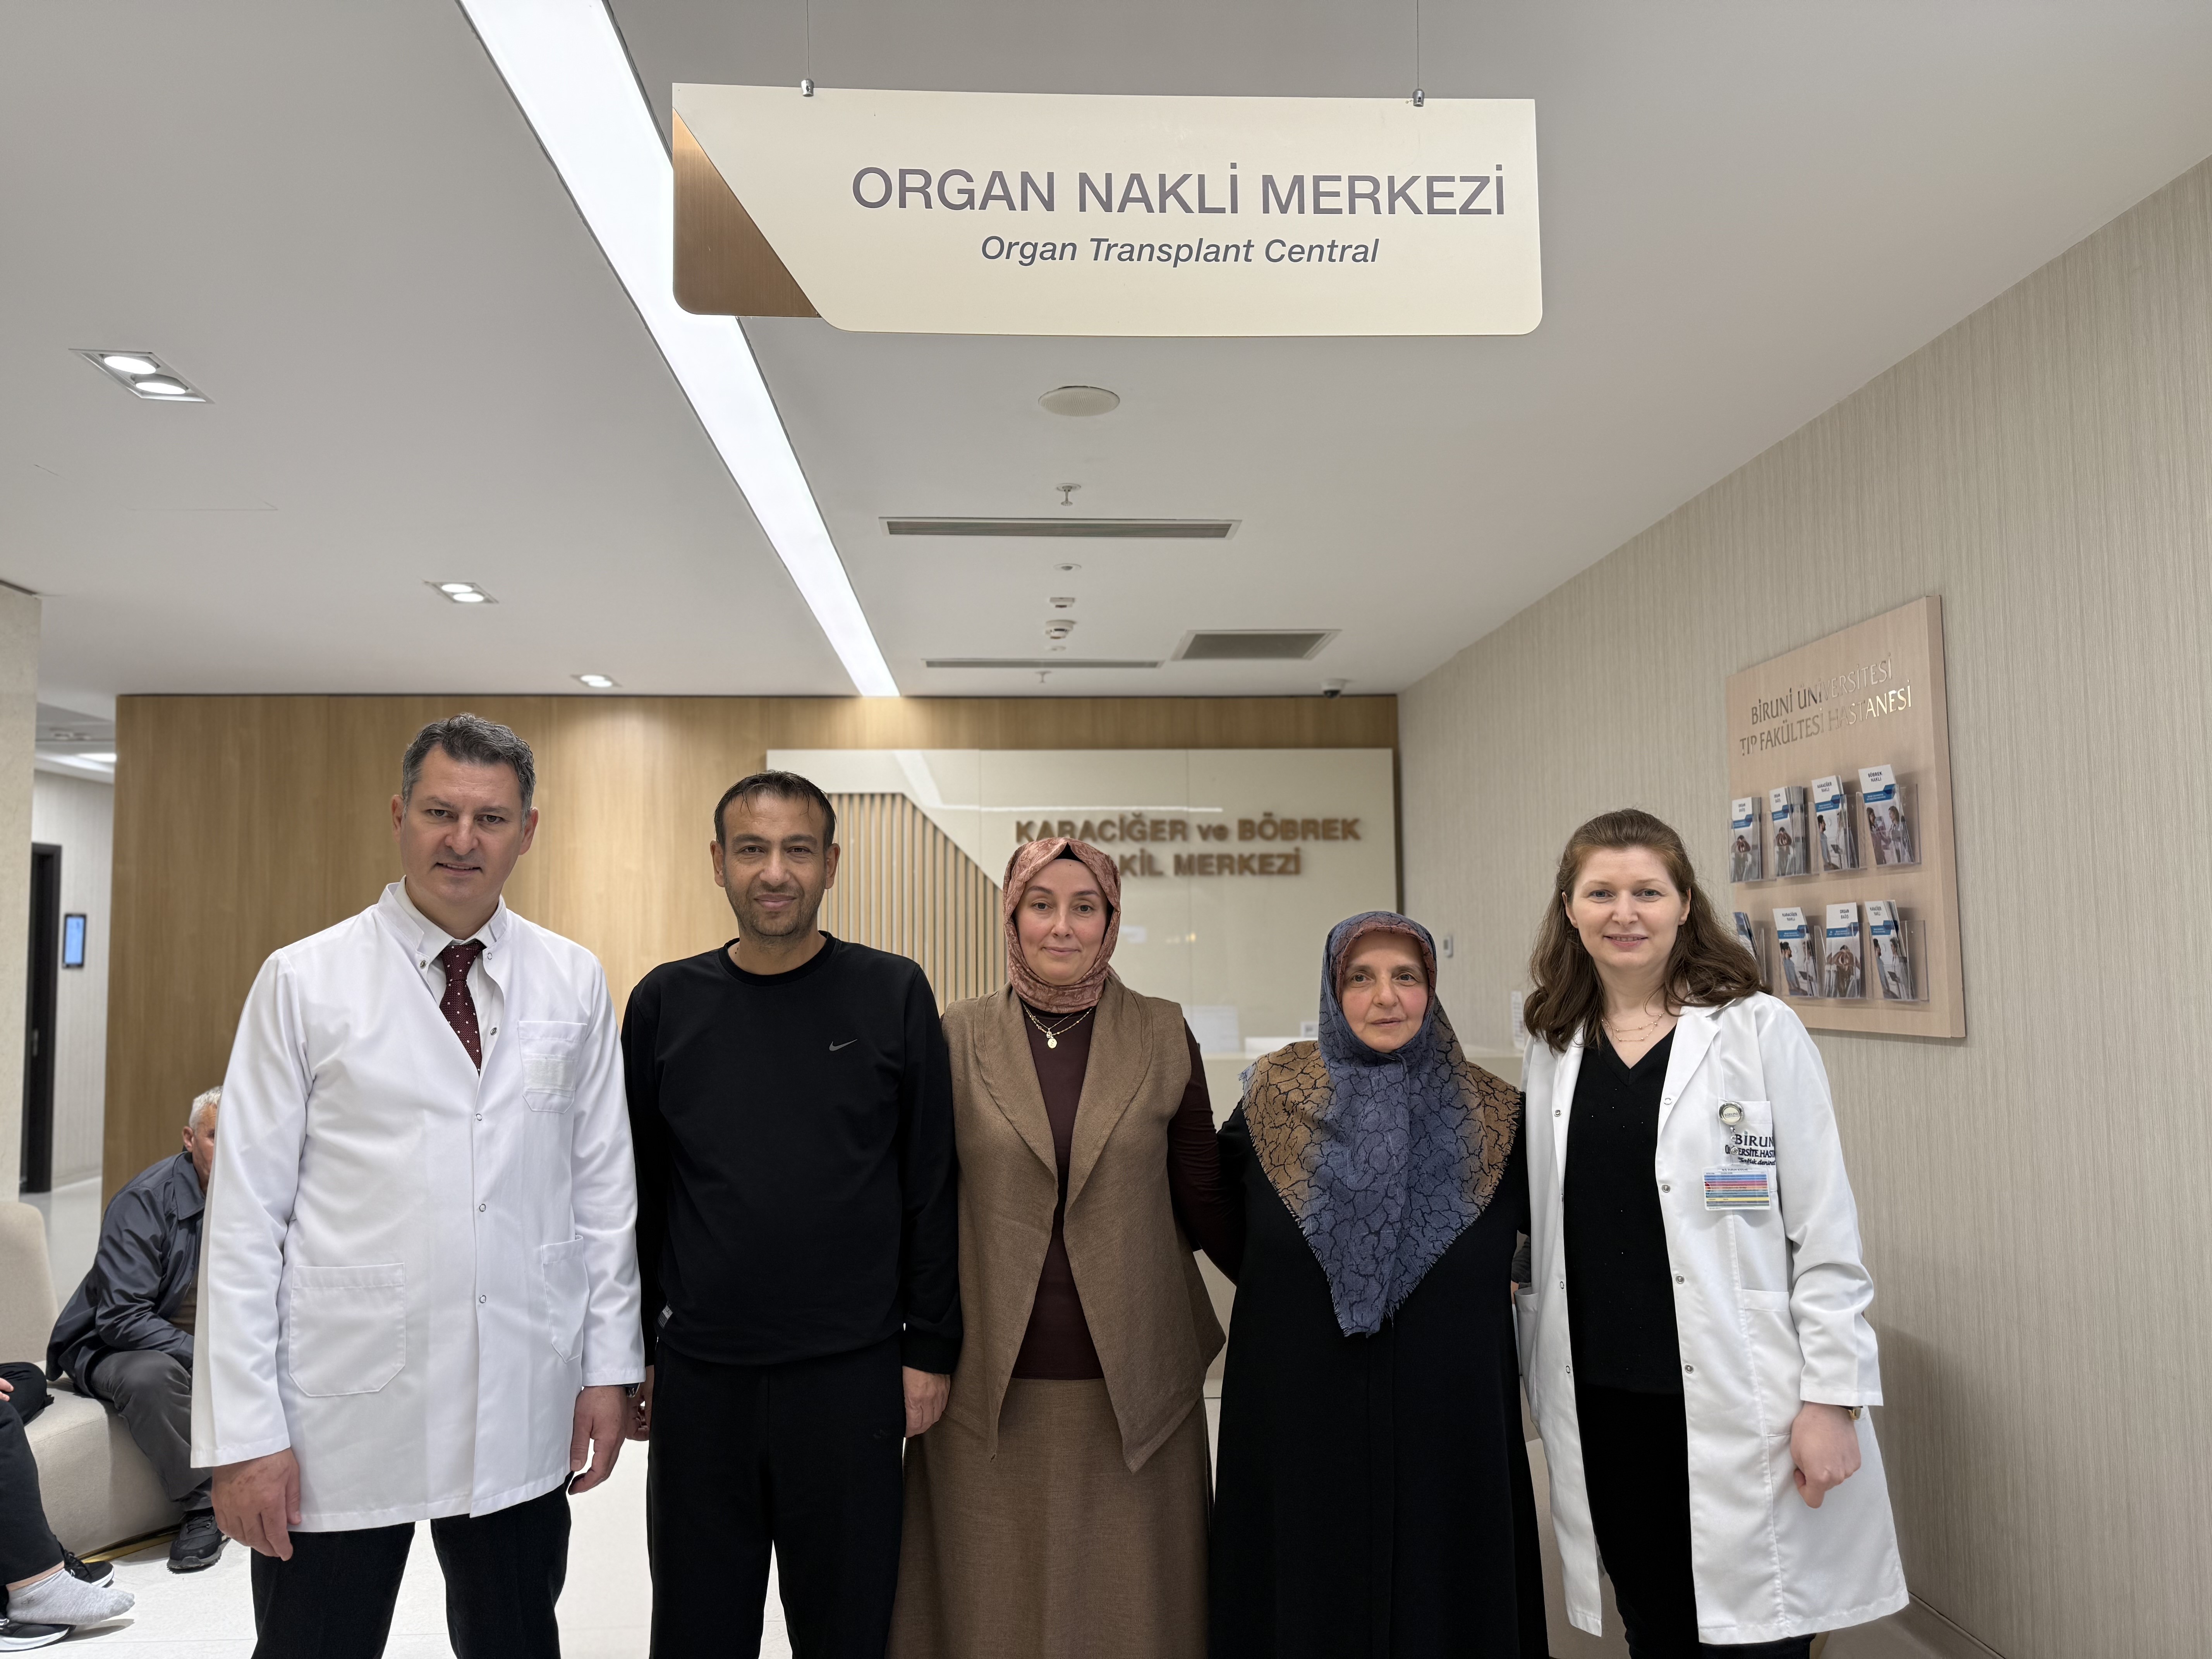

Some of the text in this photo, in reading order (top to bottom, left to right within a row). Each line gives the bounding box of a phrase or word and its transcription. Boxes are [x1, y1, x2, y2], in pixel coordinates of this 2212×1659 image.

[852, 162, 1504, 215] ORGAN NAKLİ MERKEZİ
[982, 235, 1379, 268] Organ Transplant Central
[1752, 653, 1892, 725] BİRUNİ ÜNİVERSİTESİ
[1740, 678, 1911, 756] TIP FAKÜLTESİ HASTANESİ
[1016, 811, 1362, 843] KARACİĞER ve BÖBREK
[1119, 847, 1301, 876] KİL MERKEZİ
[1735, 1130, 1774, 1147] BİRUN
